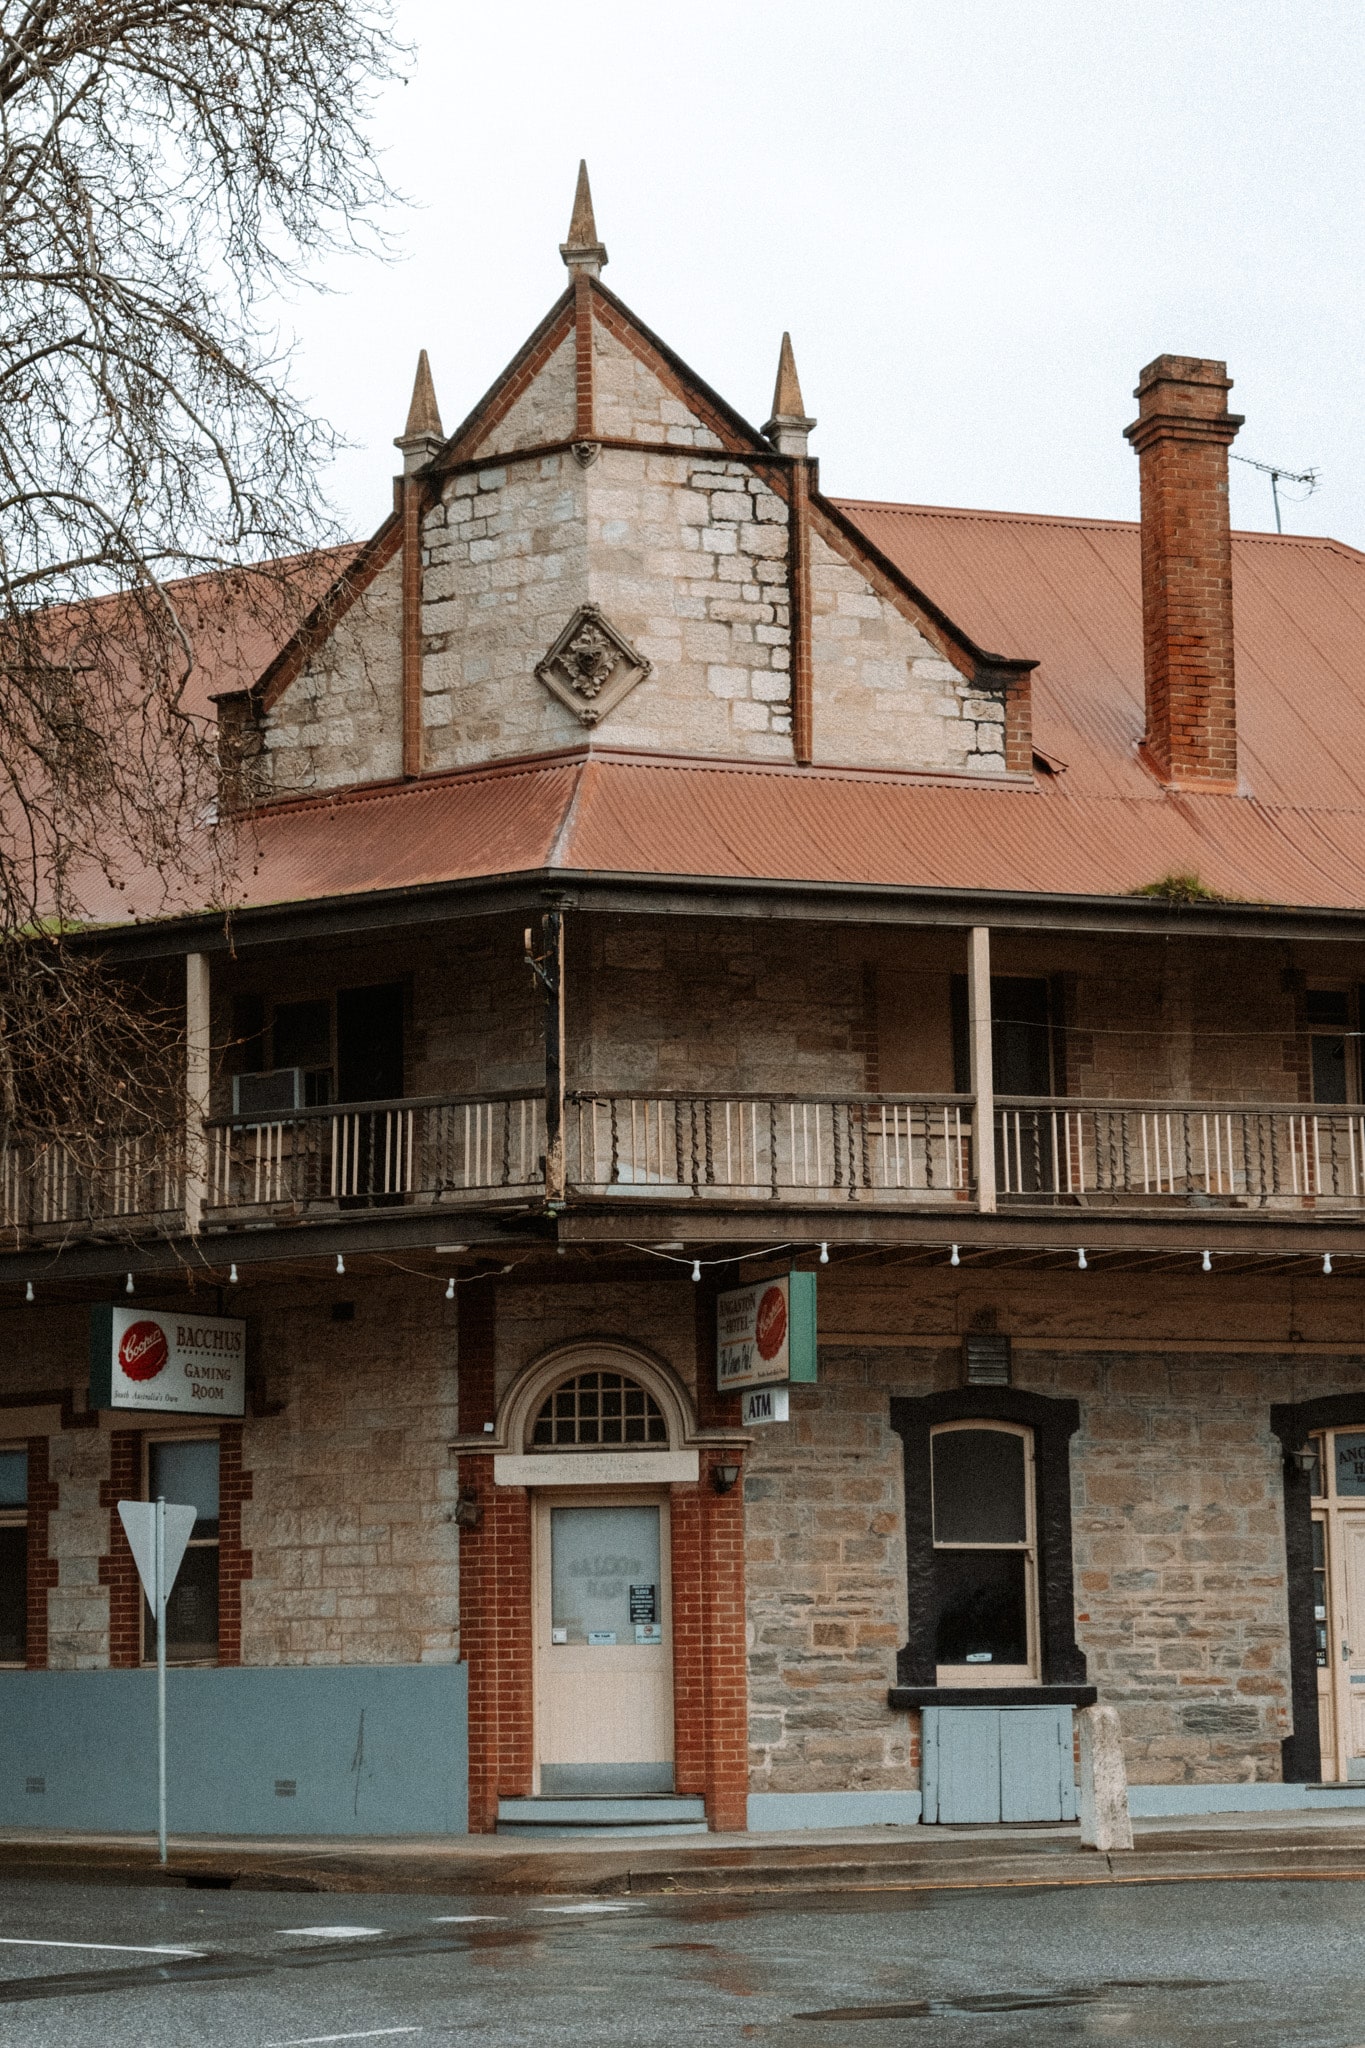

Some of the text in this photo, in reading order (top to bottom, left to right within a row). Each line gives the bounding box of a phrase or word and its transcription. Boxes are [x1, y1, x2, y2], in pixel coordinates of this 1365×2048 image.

[176, 1326, 241, 1352] BACCHUS
[184, 1363, 231, 1381] GAMING
[191, 1383, 224, 1400] ROOM
[748, 1393, 771, 1418] ATM
